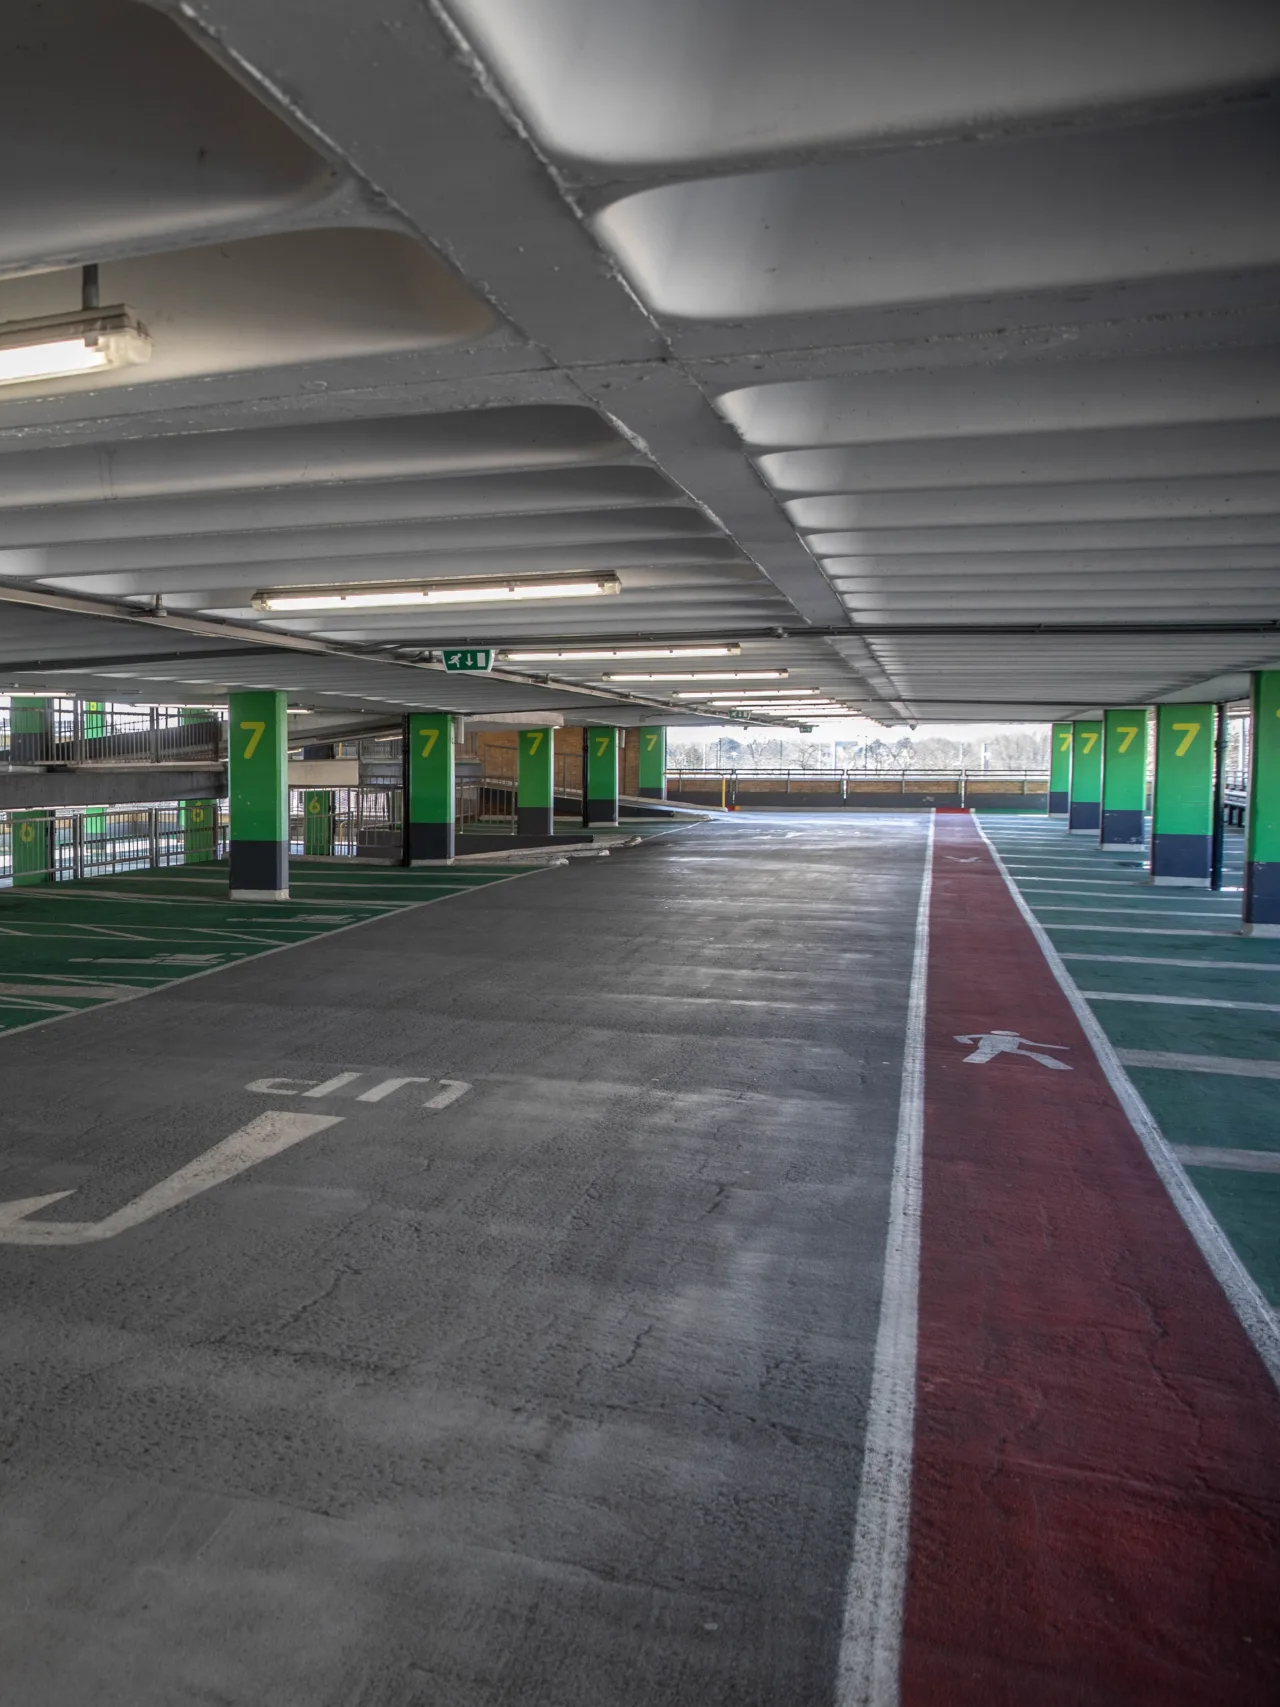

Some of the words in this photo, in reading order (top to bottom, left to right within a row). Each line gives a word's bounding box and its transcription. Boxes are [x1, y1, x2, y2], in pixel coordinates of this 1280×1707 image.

[240, 722, 265, 759] 7
[420, 729, 439, 758] 7
[527, 733, 543, 756] 7
[595, 738, 609, 757] 7
[645, 735, 658, 752] 7
[1059, 733, 1071, 752] 7
[1081, 733, 1099, 754] 7
[1117, 727, 1138, 753] 7
[1172, 723, 1200, 757] 7
[192, 801, 204, 822] 6
[309, 796, 320, 813] 6
[21, 821, 33, 843] 6
[244, 1071, 473, 1109] UP
